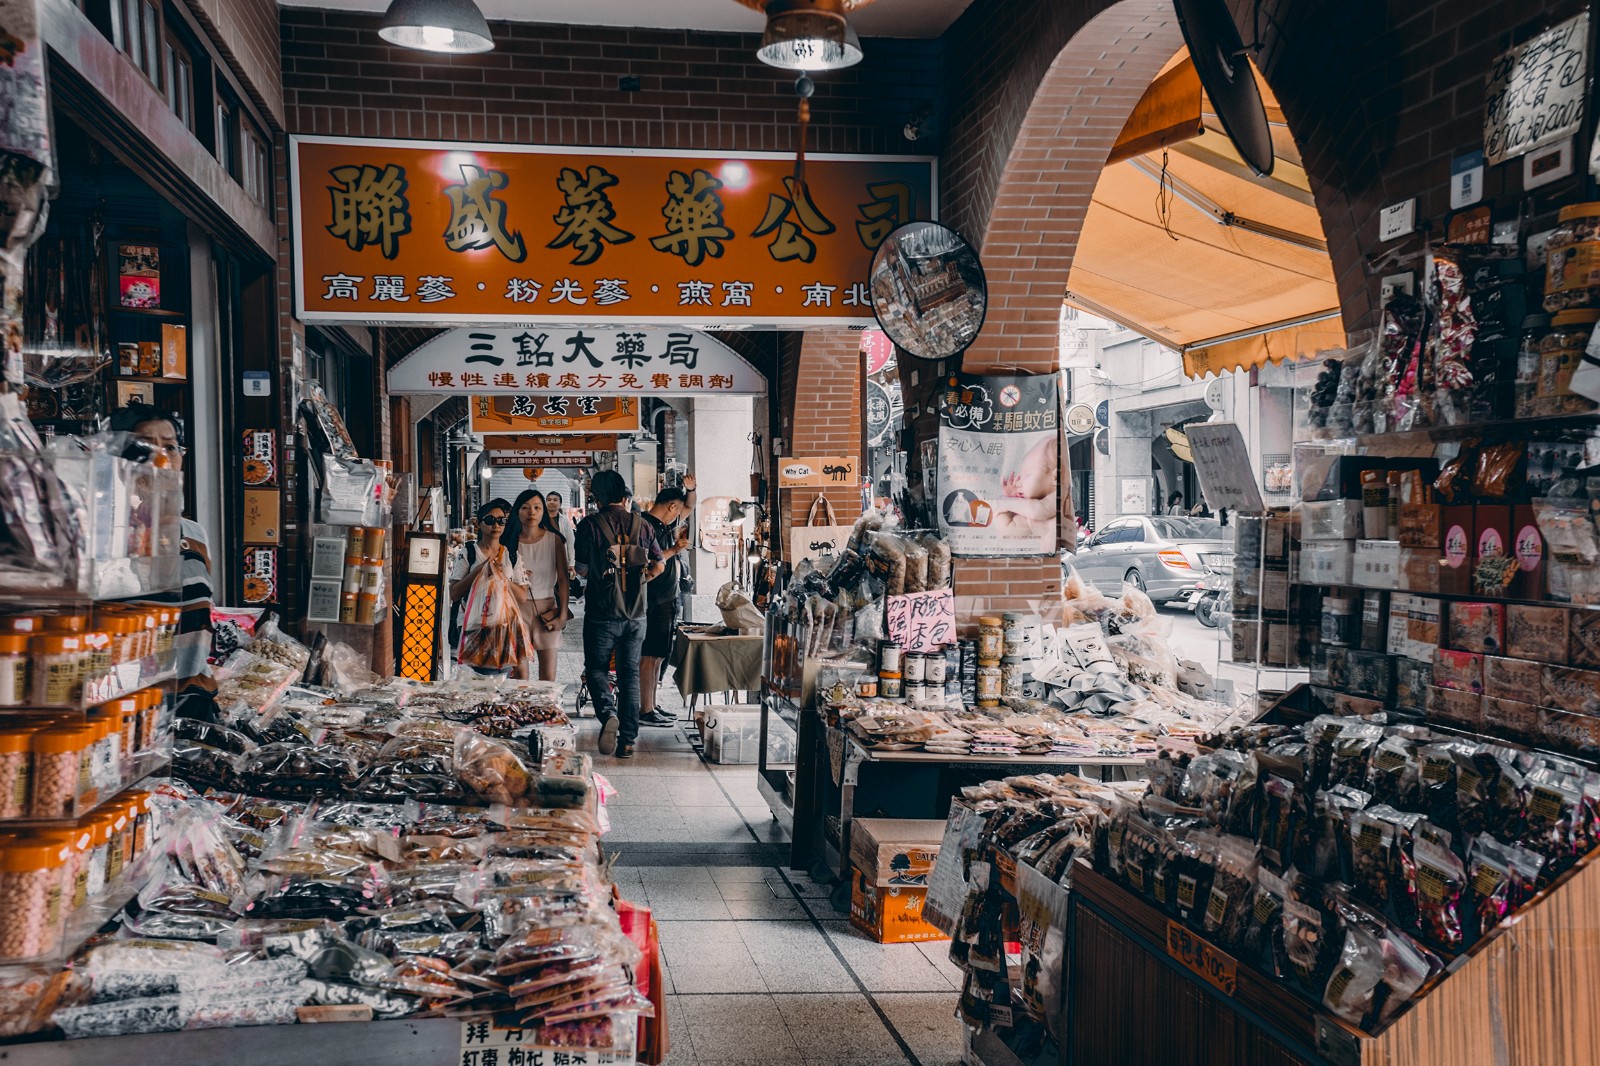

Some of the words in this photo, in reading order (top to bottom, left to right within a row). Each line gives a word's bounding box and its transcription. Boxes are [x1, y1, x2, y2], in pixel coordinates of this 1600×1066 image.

[464, 330, 699, 370] 三銘大藥局
[427, 372, 734, 389] 慢性連續處方免費調劑
[1004, 409, 1057, 431] 驅蚊包
[945, 437, 1003, 456] 安心入眠
[785, 468, 797, 476] Why
[904, 894, 921, 912] 新
[508, 1048, 544, 1066] 枸杞
